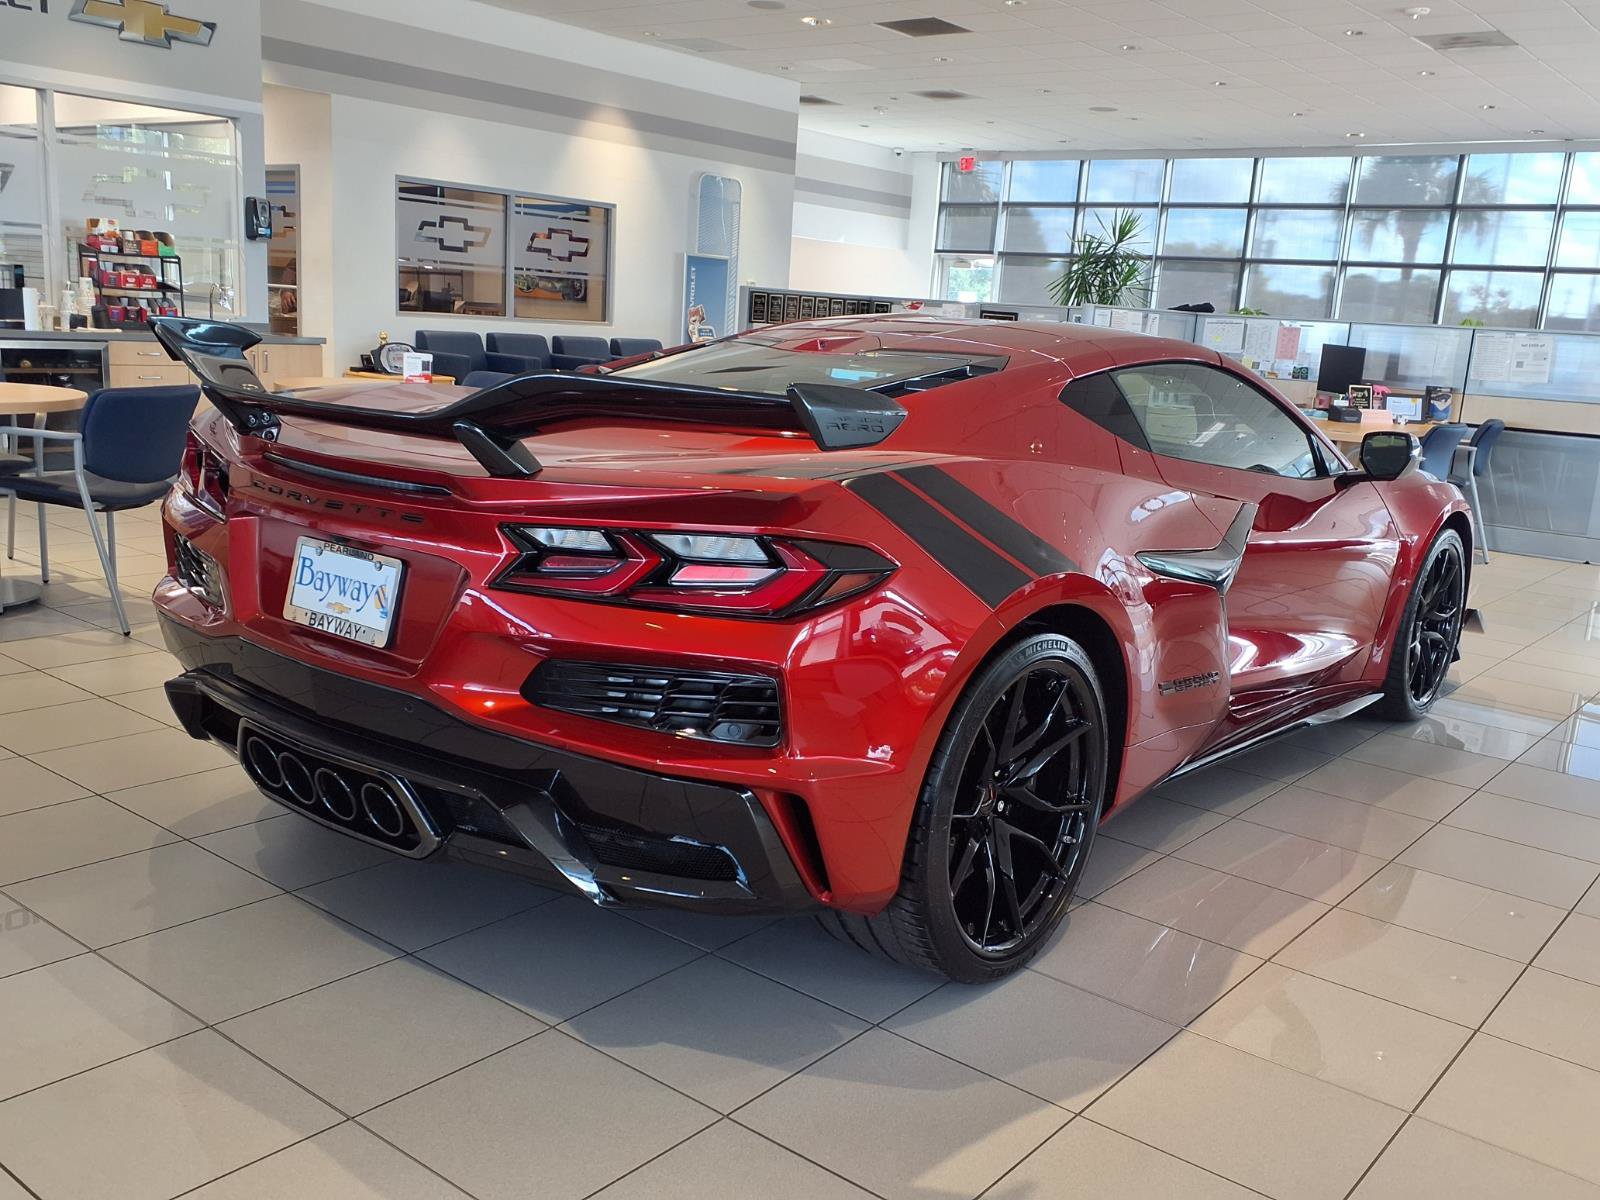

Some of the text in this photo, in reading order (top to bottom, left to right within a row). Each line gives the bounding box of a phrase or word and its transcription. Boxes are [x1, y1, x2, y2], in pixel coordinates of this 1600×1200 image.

[826, 422, 885, 433] AERO
[253, 480, 424, 523] CORVETTE
[323, 542, 375, 561] PEARLND
[296, 556, 377, 612] Bayway
[308, 612, 361, 638] BAYWAY
[1025, 640, 1067, 657] MICHELIN
